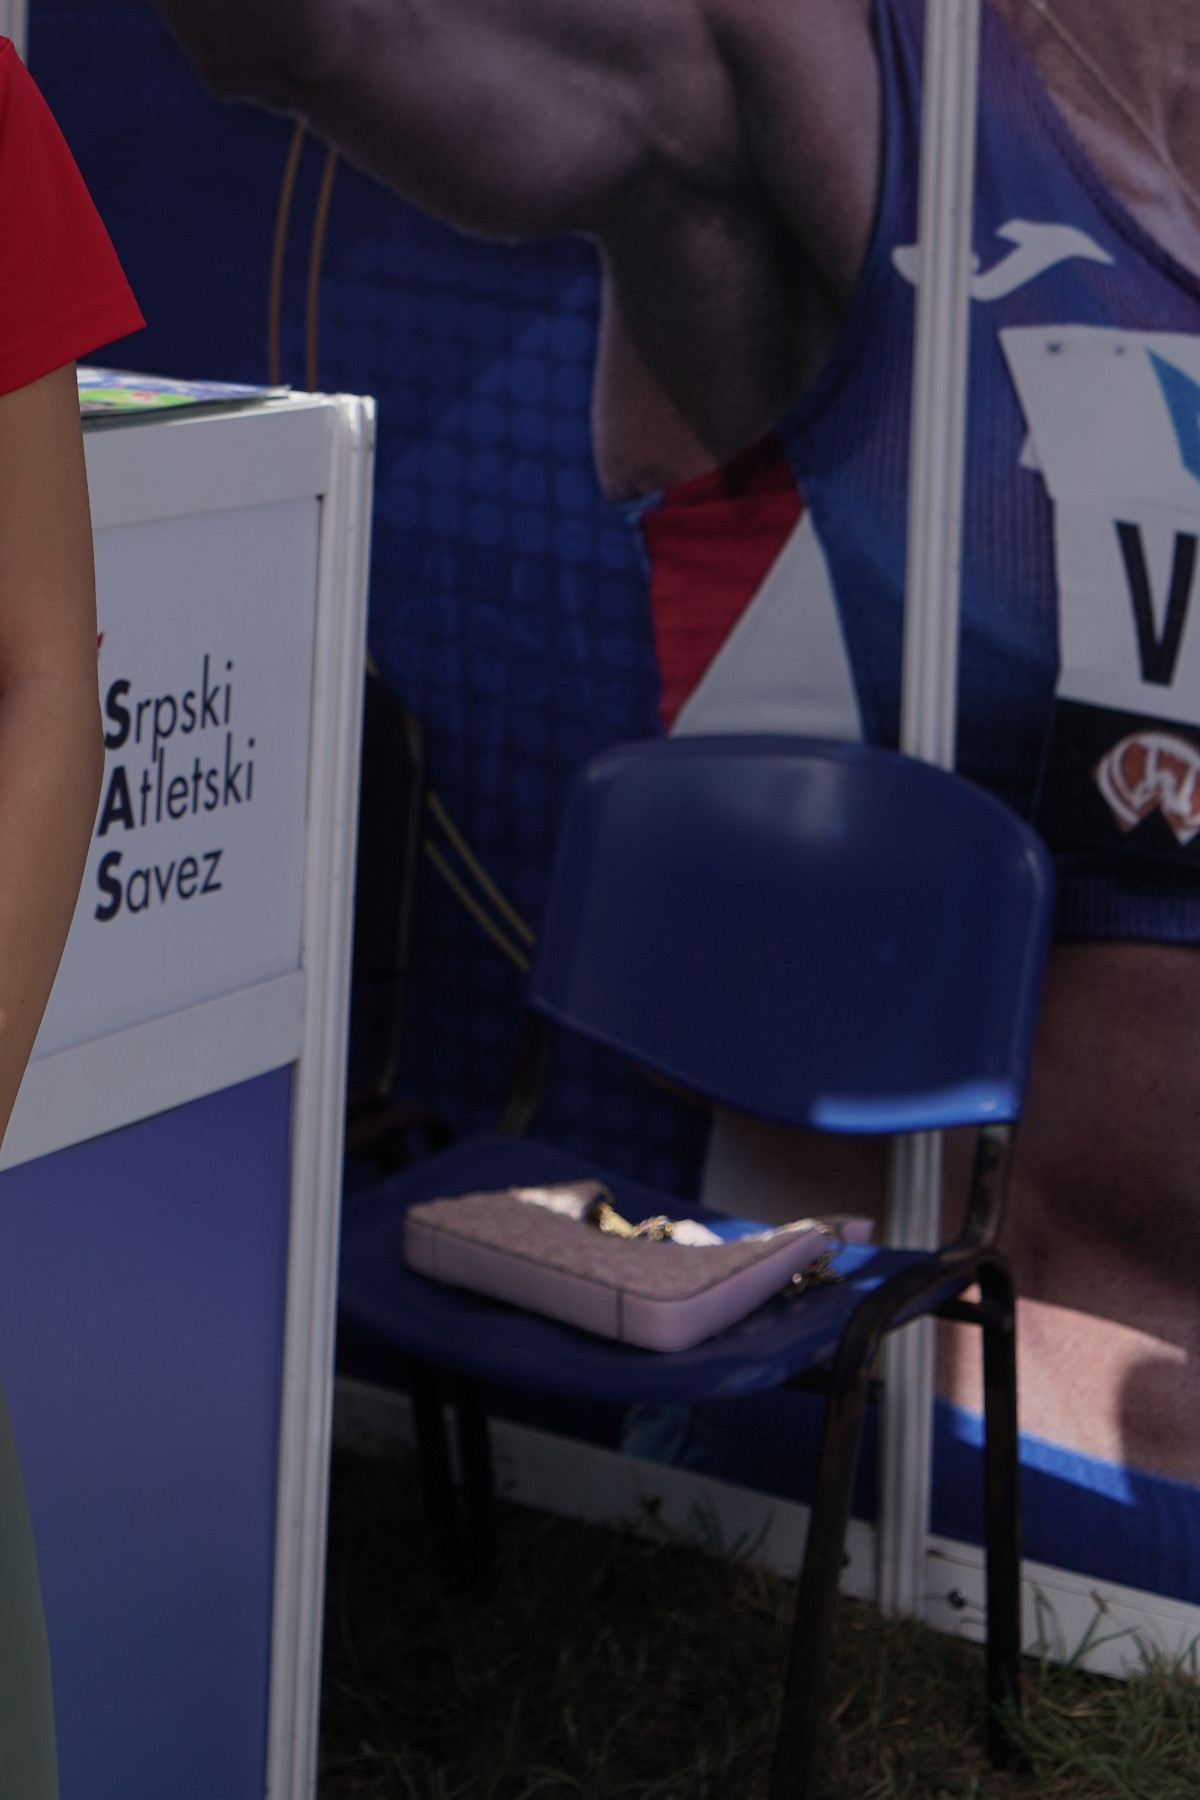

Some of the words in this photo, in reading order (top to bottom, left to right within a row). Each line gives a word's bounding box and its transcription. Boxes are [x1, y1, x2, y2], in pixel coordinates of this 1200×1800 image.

[103, 653, 235, 764] Srpski
[96, 731, 256, 838] Atletski
[93, 849, 225, 923] Savez
